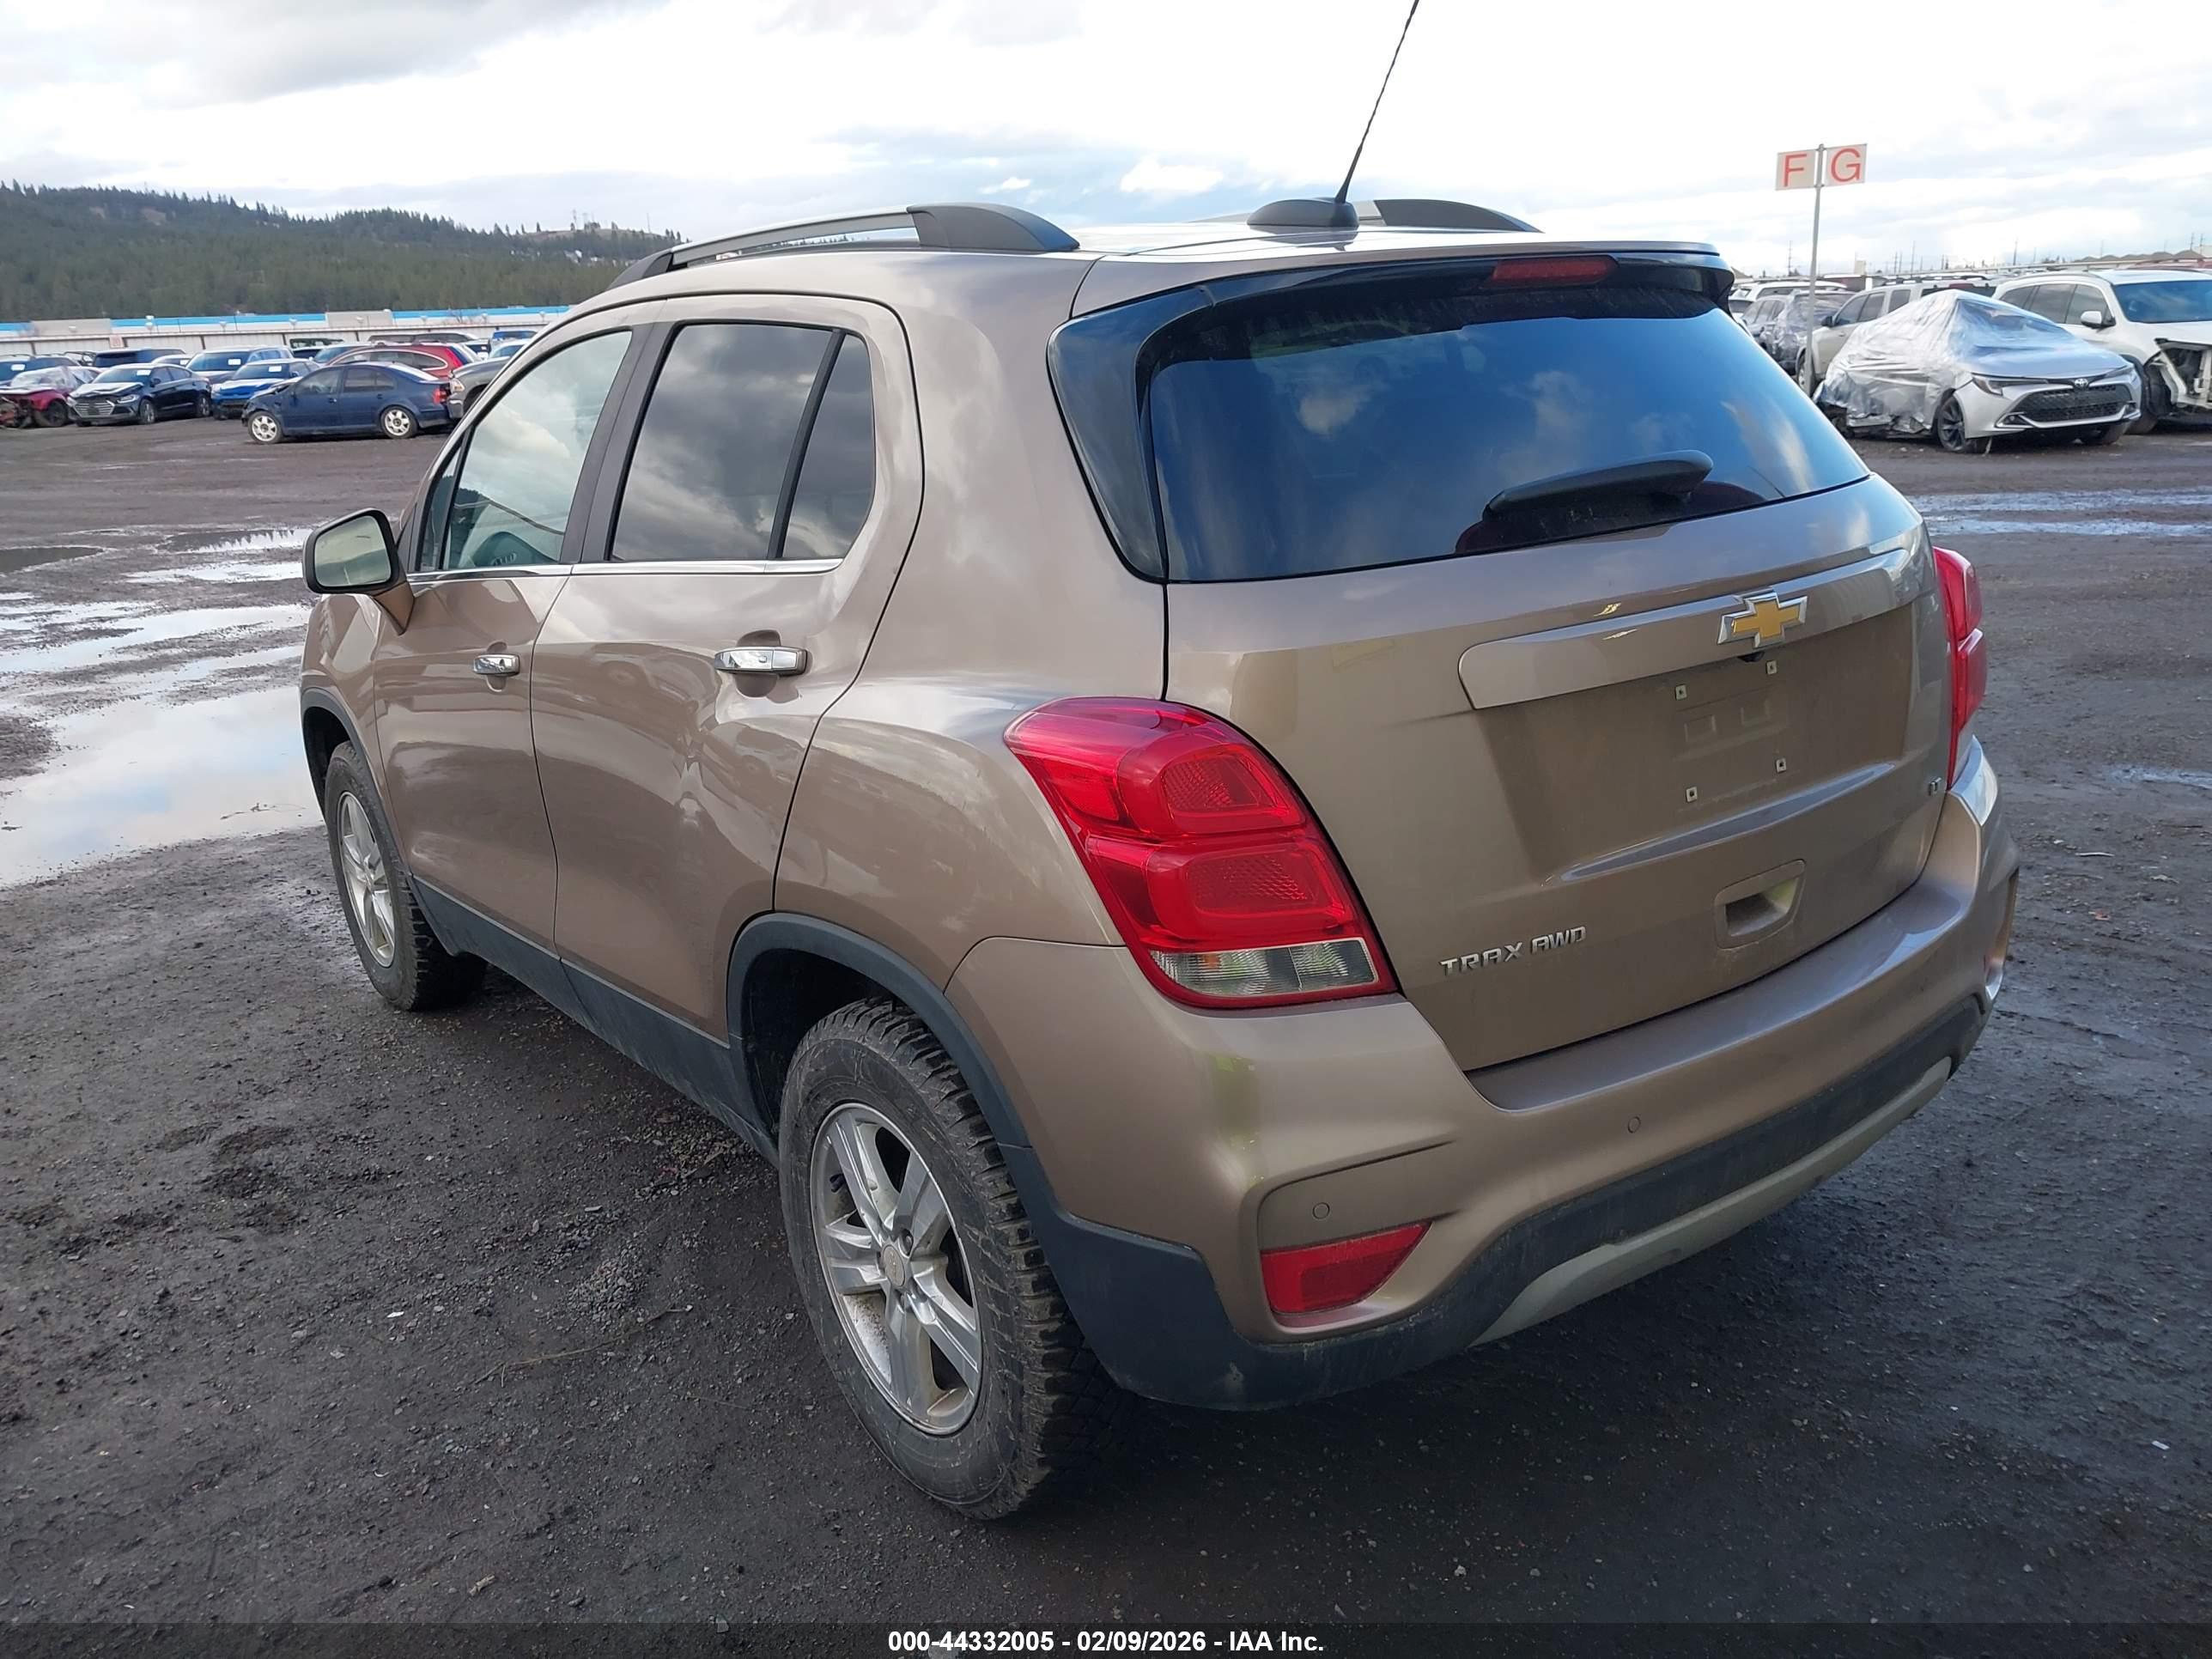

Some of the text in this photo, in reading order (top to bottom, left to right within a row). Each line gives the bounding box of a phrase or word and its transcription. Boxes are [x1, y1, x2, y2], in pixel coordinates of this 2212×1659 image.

[1784, 154, 1808, 187] F
[1831, 148, 1861, 183] G
[1439, 925, 1587, 975] TRAX AWD
